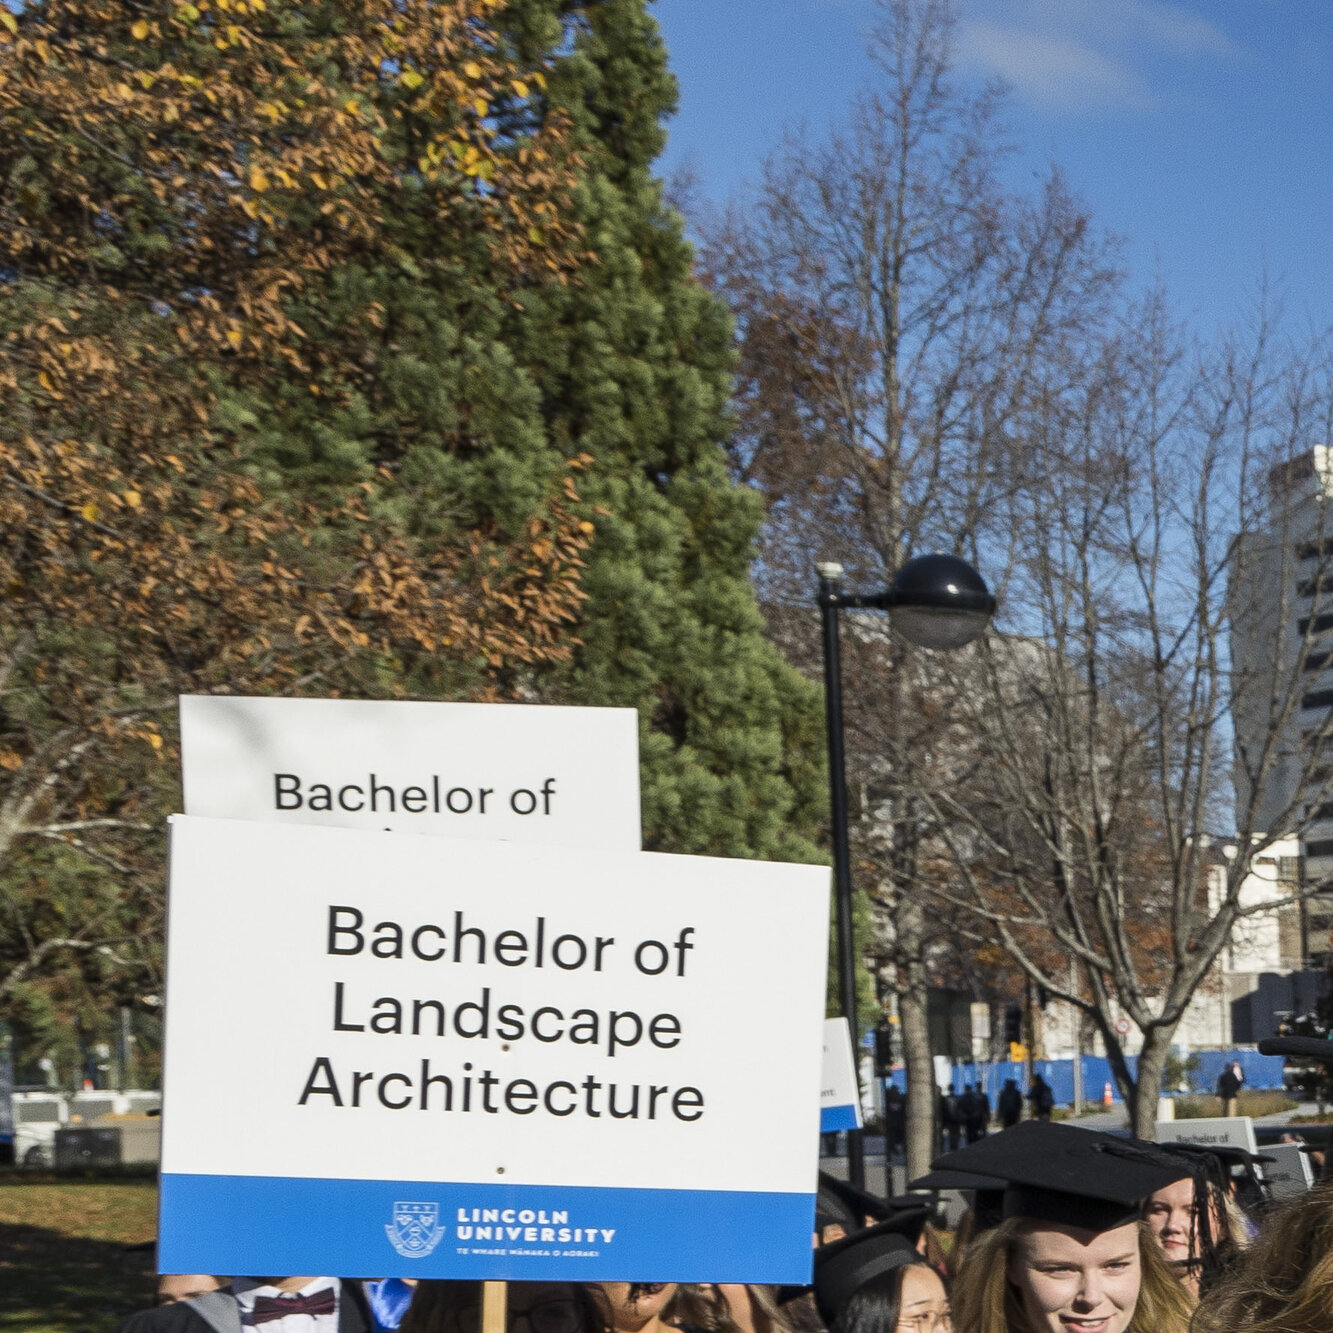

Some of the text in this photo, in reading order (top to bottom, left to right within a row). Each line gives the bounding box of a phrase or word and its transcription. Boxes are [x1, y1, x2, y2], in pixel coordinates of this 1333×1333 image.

[273, 773, 556, 815] Bachelor of
[327, 905, 695, 977] Bachelor of
[333, 981, 681, 1057] Landscape
[297, 1056, 704, 1122] Architecture
[456, 1225, 616, 1244] UNIVERSITY
[457, 1207, 568, 1225] LINCOLN
